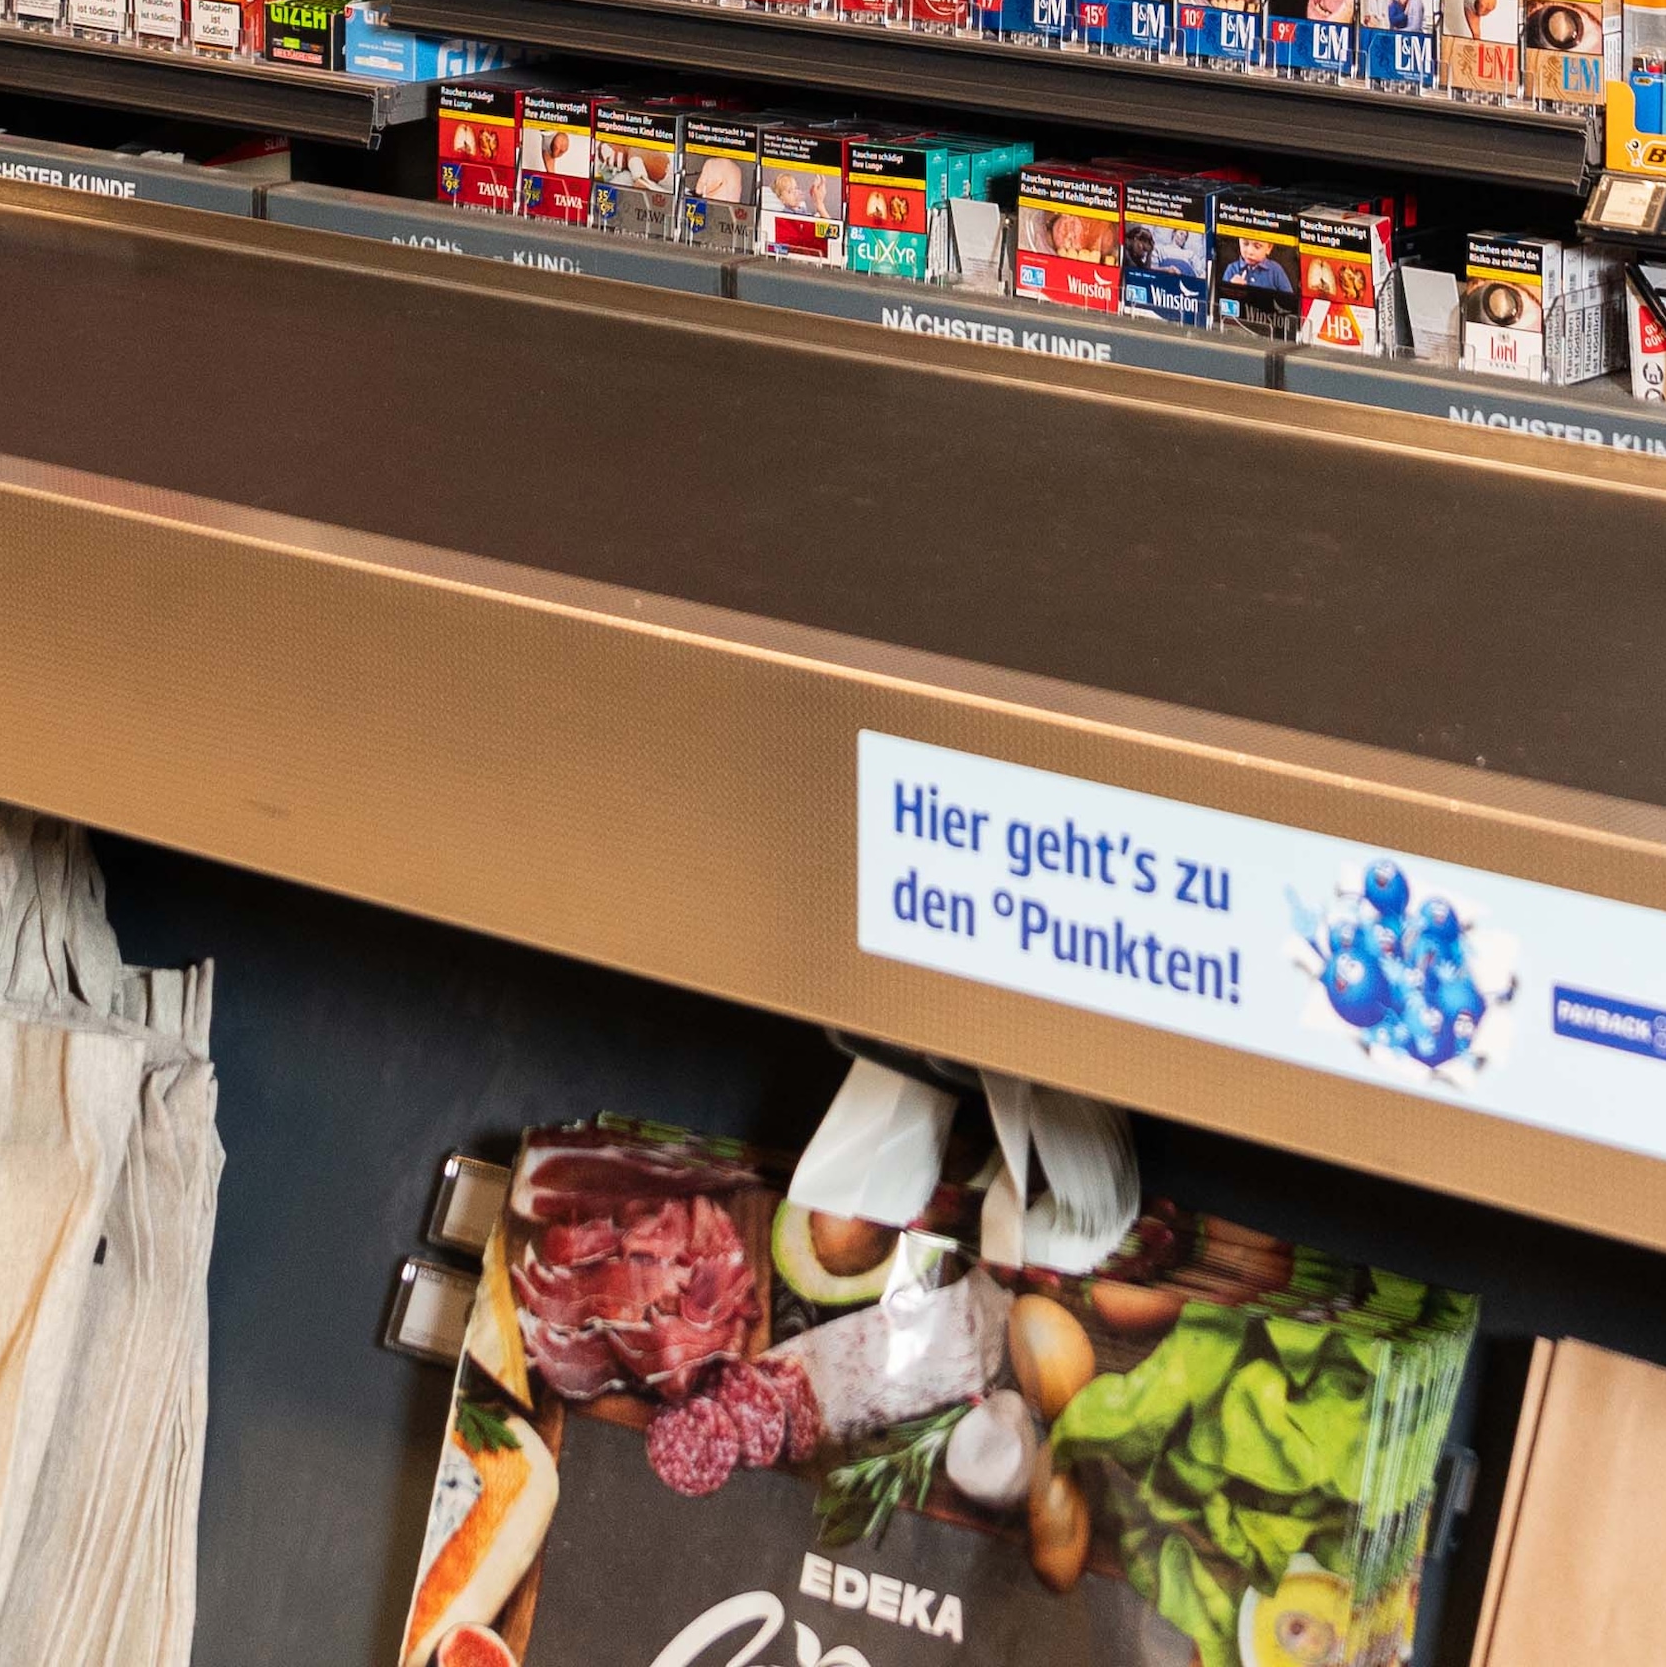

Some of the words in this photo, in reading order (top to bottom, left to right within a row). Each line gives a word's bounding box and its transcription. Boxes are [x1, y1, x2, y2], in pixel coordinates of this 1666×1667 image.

[69, 170, 136, 201] KUNDE
[882, 305, 1014, 348] NÄCHSTER
[1022, 331, 1112, 363] KUNDE
[893, 780, 989, 854] Hier
[1006, 818, 1157, 896] geht's
[1174, 860, 1231, 914] zu
[892, 867, 975, 940] den
[993, 888, 1242, 1006] °Punkten!
[798, 1552, 964, 1644] EDEKA
